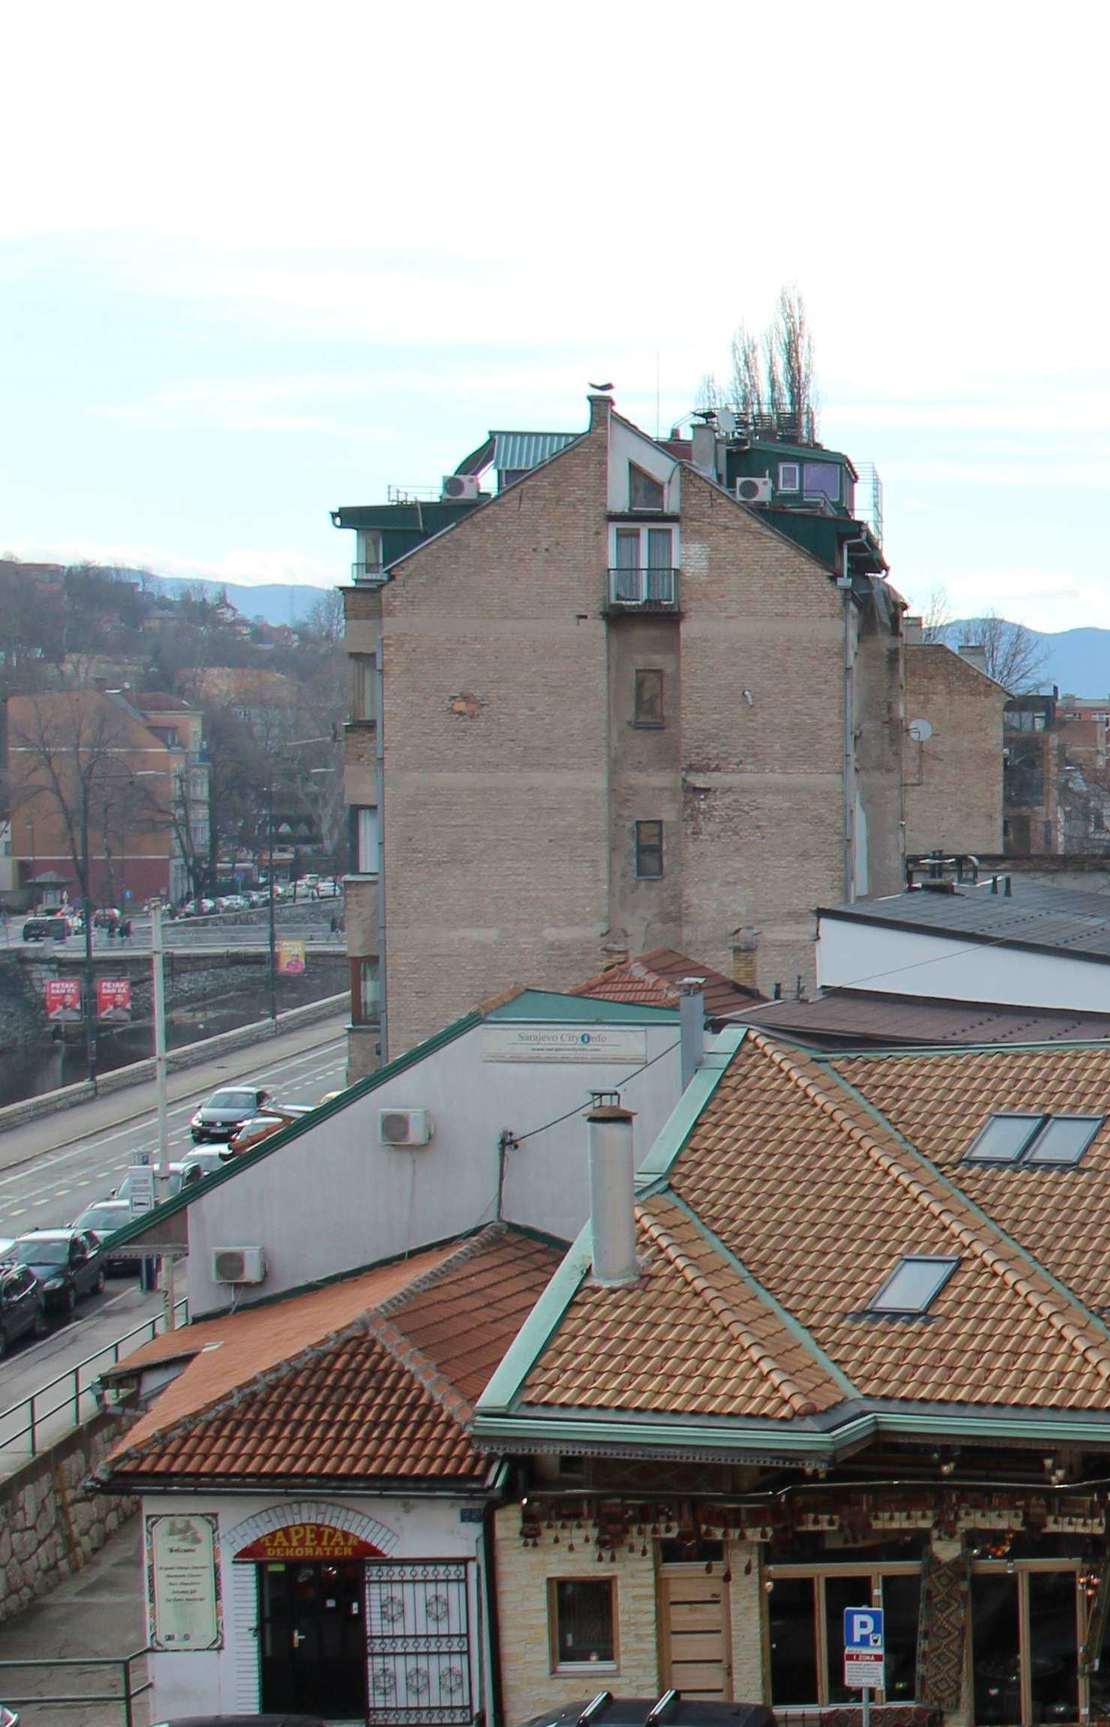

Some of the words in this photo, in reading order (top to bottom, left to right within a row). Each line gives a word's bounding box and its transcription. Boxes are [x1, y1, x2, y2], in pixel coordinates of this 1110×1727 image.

[518, 1032, 558, 1045] Sarajevo
[560, 1033, 579, 1045] City
[852, 1615, 874, 1642] P
